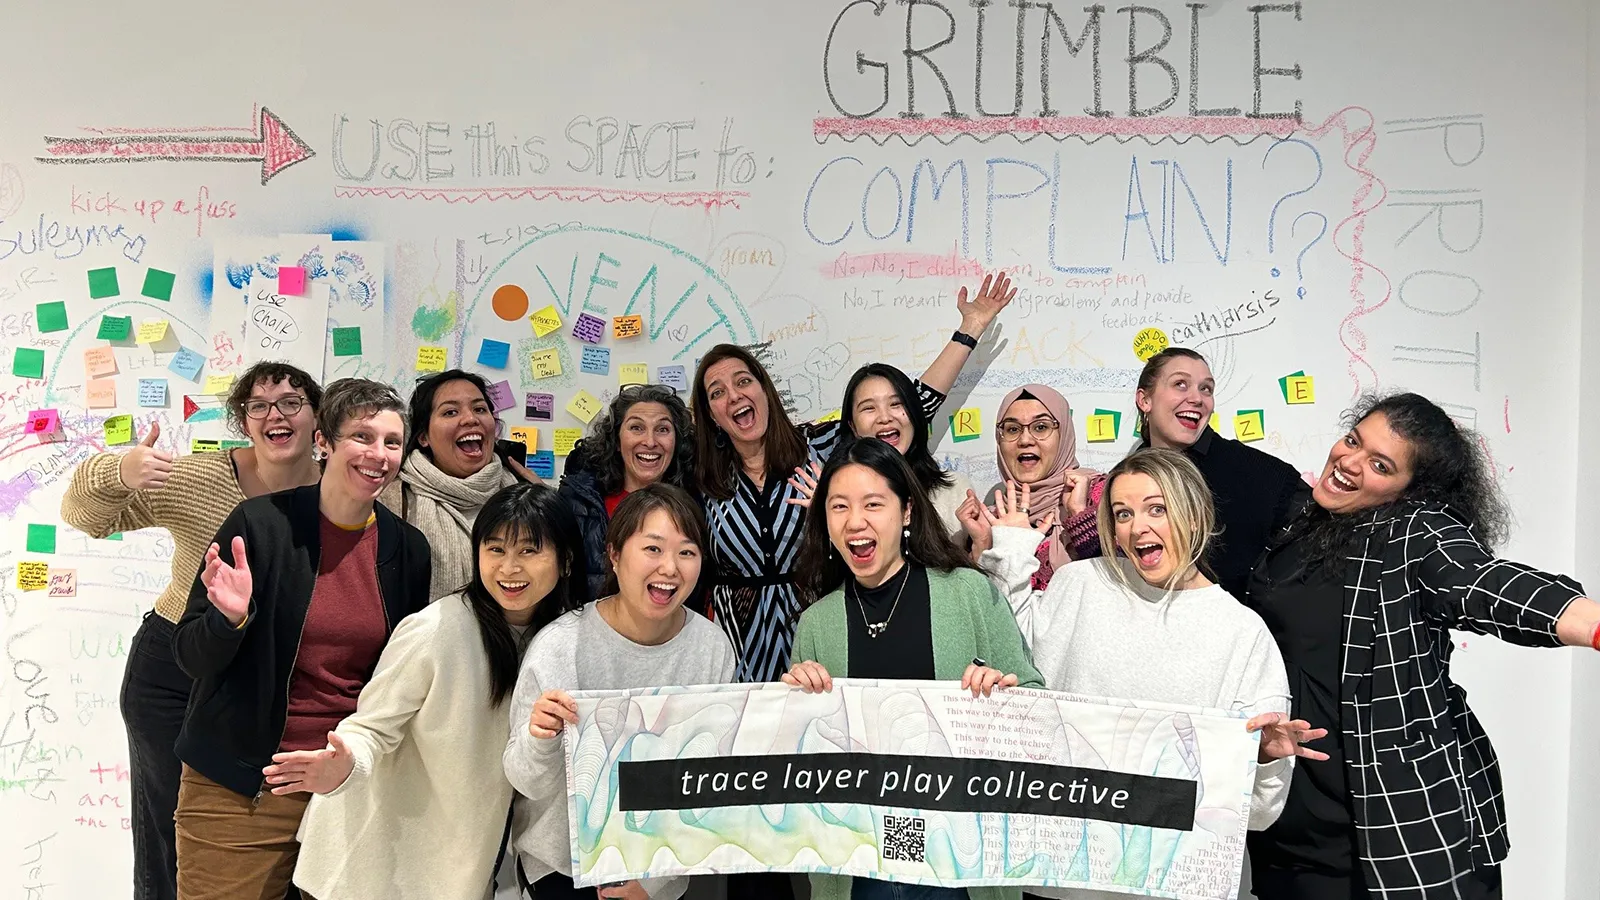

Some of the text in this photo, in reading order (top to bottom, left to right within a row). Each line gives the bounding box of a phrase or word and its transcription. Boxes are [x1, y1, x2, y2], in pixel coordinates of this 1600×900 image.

[824, 0, 1303, 119] GRUMBLE
[332, 113, 455, 182] USE
[565, 113, 700, 182] SPACE
[71, 184, 127, 214] kick
[134, 199, 165, 223] up
[193, 185, 237, 237] fuss
[256, 289, 287, 308] use
[536, 250, 742, 362] VENT
[892, 291, 949, 308] meant
[1110, 290, 1142, 307] and
[1143, 285, 1194, 313] provide
[253, 308, 293, 335] Chalk
[1171, 289, 1281, 345] catharsis
[1295, 381, 1308, 400] E
[957, 412, 975, 434] R
[1239, 420, 1255, 437] Z
[943, 695, 959, 703] This
[977, 696, 985, 704] to
[987, 698, 1000, 706] the
[1008, 688, 1026, 697] way
[1028, 689, 1038, 698] to
[1040, 690, 1055, 700] the
[1056, 693, 1090, 704] archive
[945, 708, 1037, 722] This way to the archive
[950, 720, 1044, 736] This way to the archive
[954, 733, 1051, 749] This way to the archive
[958, 746, 977, 755] This
[978, 748, 994, 757] way
[997, 748, 1007, 758] to
[1009, 749, 1023, 759] the
[681, 762, 1130, 810] trace layer play collective
[1021, 814, 1032, 823] to
[1038, 828, 1057, 838] the
[1059, 828, 1100, 841] archve
[1043, 840, 1062, 851] the
[1197, 848, 1219, 859] This
[1183, 855, 1229, 869] This way
[1195, 866, 1217, 876] way
